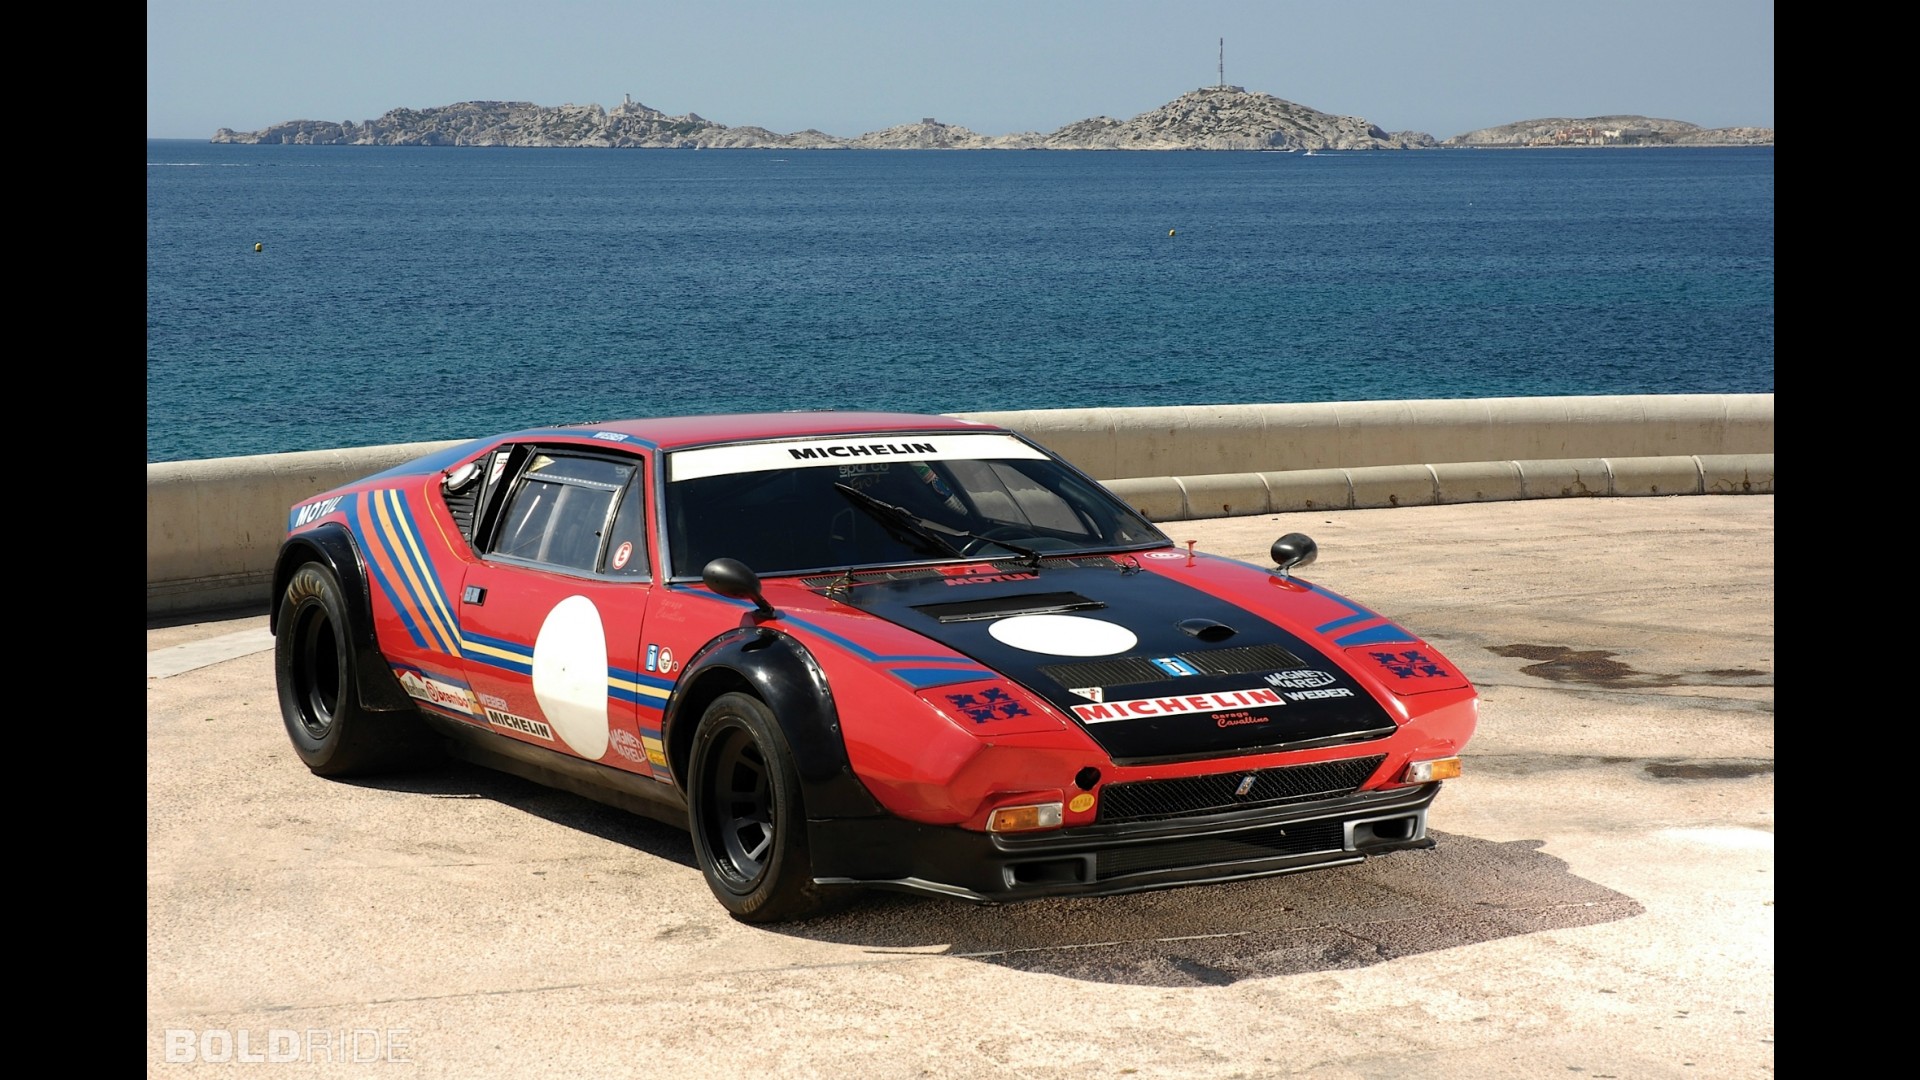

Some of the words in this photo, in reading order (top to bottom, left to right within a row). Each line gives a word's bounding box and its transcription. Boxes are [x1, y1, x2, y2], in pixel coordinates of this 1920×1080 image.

[787, 443, 938, 460] MICHELIN
[295, 495, 344, 528] MOTUL
[944, 572, 1040, 586] MOTUL
[476, 691, 509, 712] WEBER
[1284, 687, 1355, 701] WEBER
[1073, 689, 1282, 721] MICHELIN
[488, 710, 550, 738] MICHELIN
[1211, 711, 1249, 720] Garage
[1217, 714, 1270, 728] Cavallino
